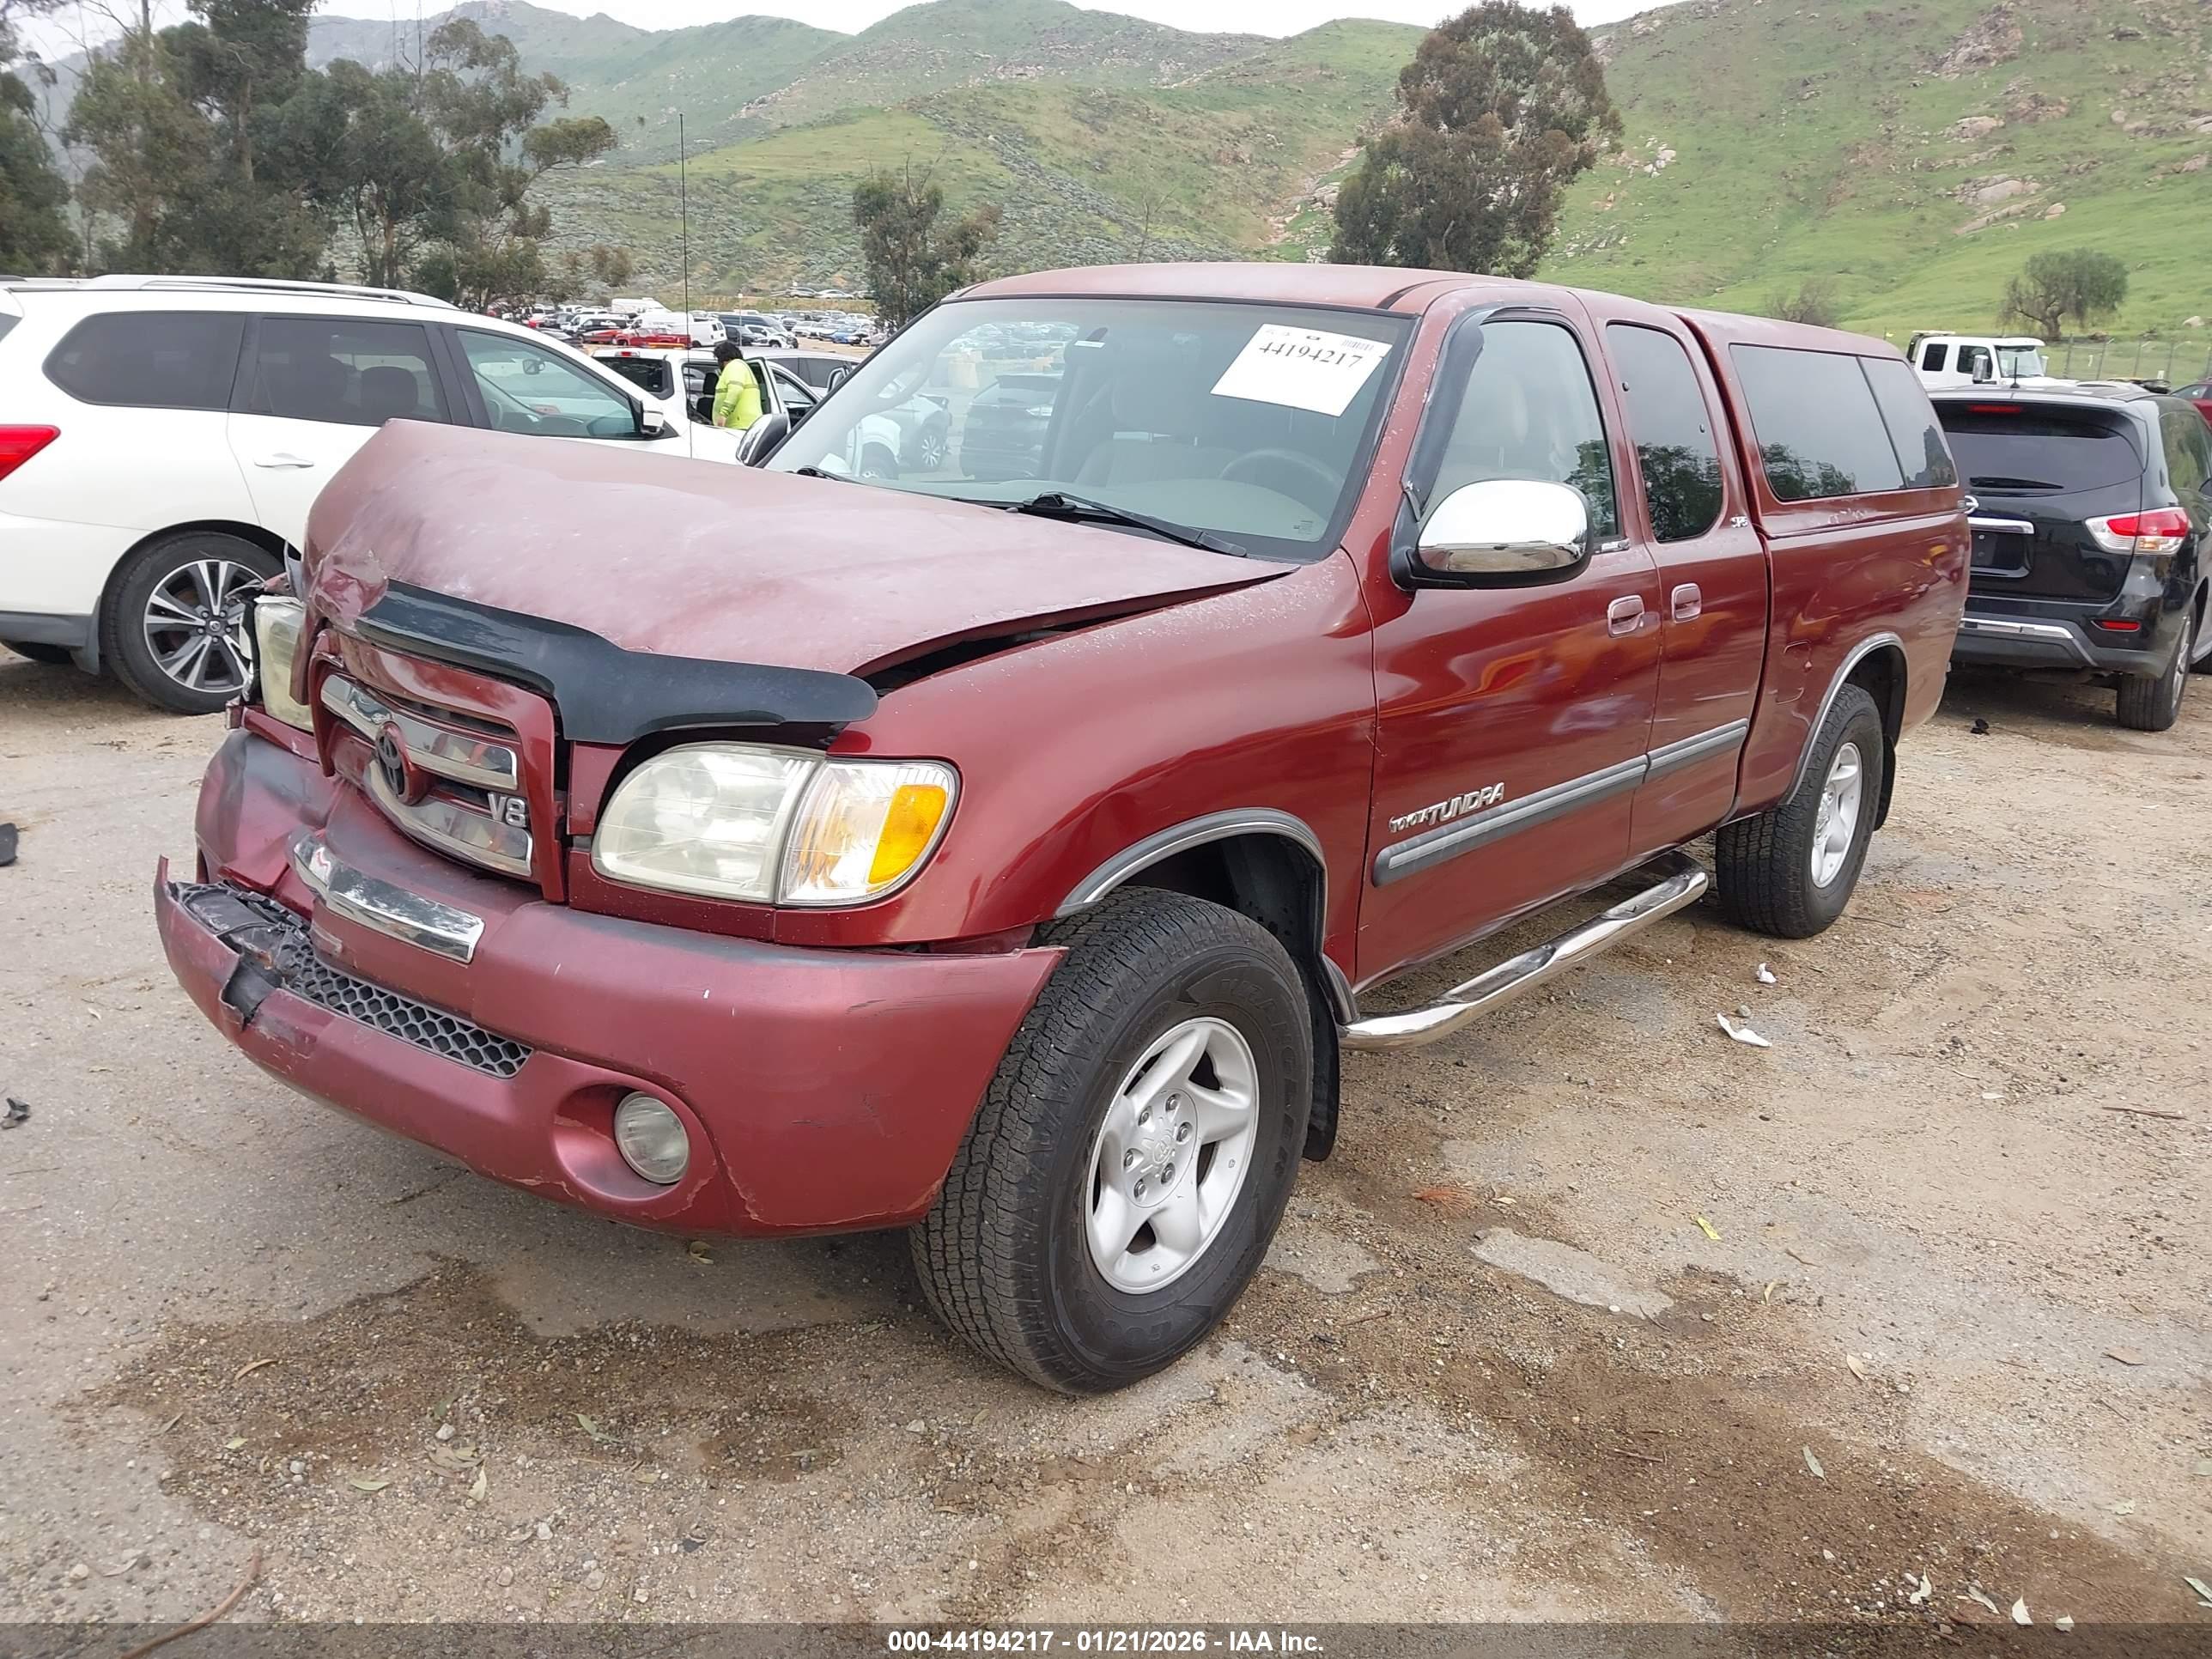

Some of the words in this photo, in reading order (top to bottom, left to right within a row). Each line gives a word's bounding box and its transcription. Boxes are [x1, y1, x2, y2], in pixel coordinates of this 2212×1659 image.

[1259, 342, 1363, 368] 44194217
[488, 792, 527, 828] V8
[1389, 809, 1429, 833] TOYOTA
[1427, 782, 1504, 826] TUNDRA
